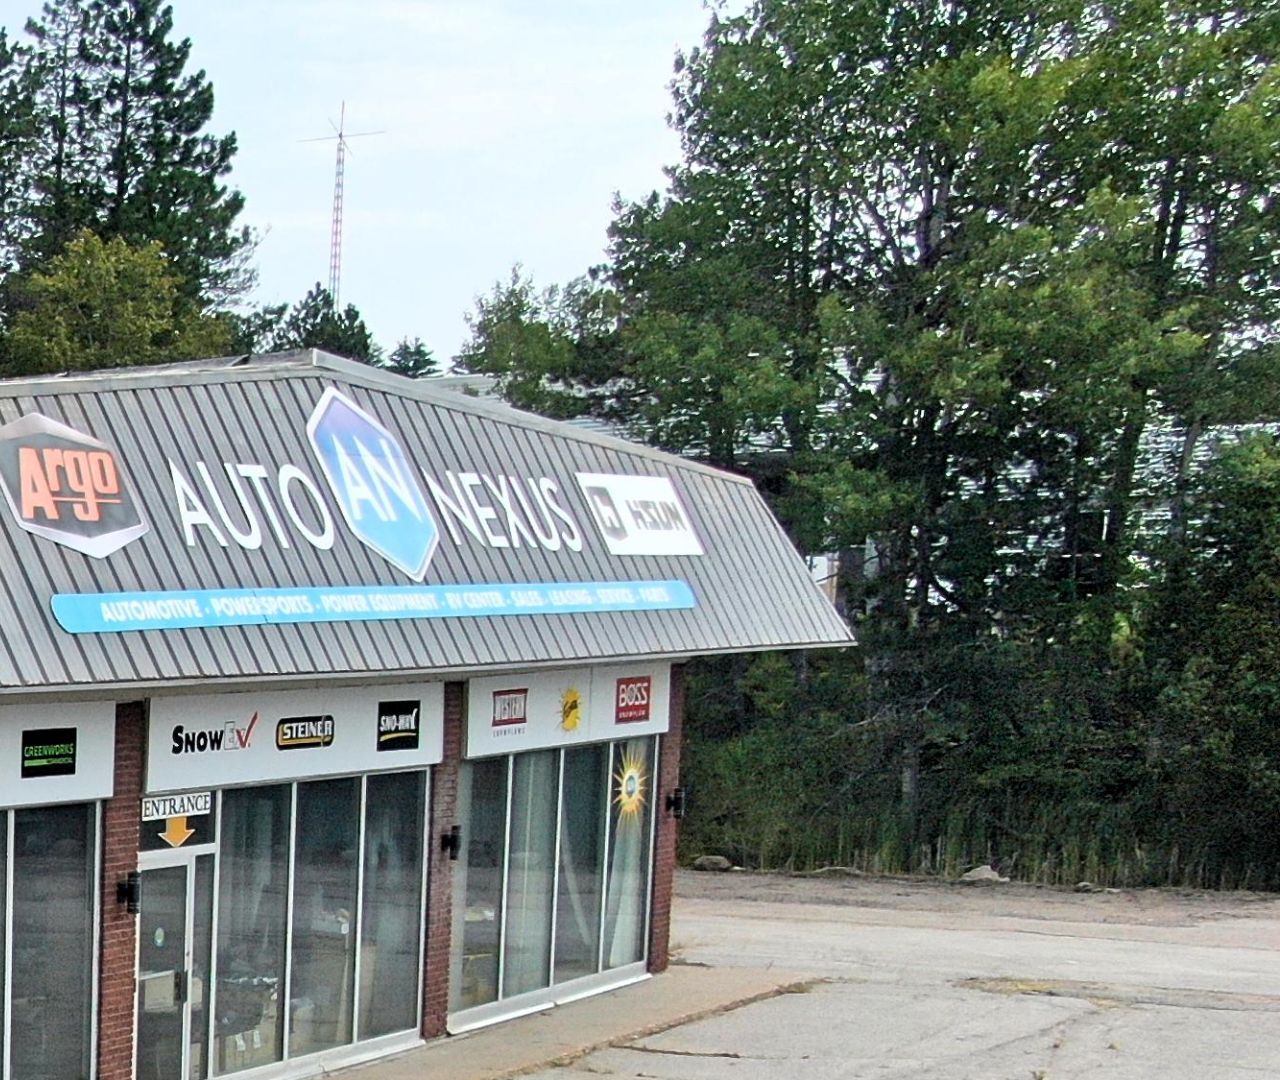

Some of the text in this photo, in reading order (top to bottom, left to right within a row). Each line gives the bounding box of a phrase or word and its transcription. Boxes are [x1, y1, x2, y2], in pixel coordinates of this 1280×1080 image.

[19, 447, 122, 522] Argo
[168, 434, 582, 552] AUTO AN NEXUS
[100, 599, 203, 622] AUTOMOTIVE
[210, 595, 314, 618] POWERSPORTS
[320, 594, 368, 613] POWER
[368, 593, 438, 612] EQUIPMENT
[619, 682, 649, 707] BOSS
[283, 719, 333, 739] STEINER
[143, 795, 210, 817] ENTRANCE
